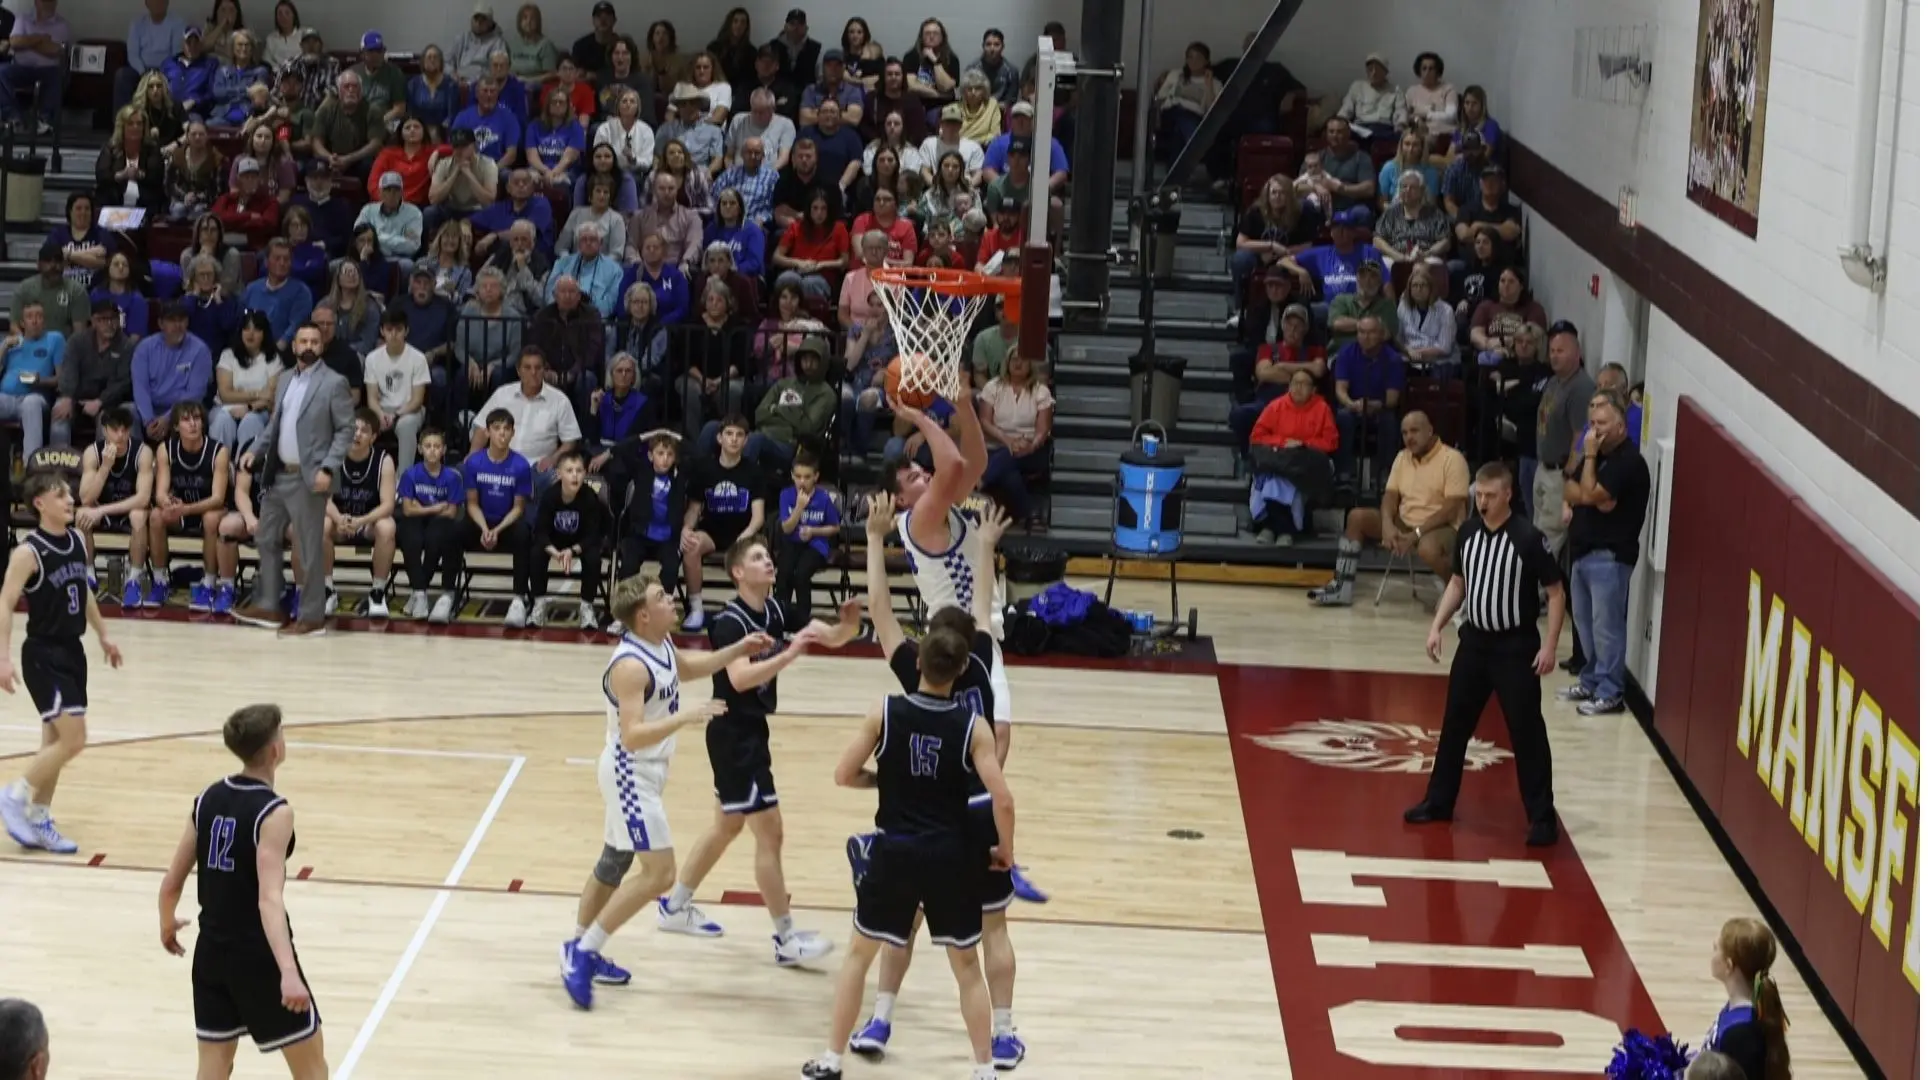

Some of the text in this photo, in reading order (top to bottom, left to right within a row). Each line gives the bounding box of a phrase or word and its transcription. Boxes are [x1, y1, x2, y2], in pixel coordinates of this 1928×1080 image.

[36, 451, 80, 468] LIONS
[67, 583, 80, 615] 3
[909, 733, 942, 780] 15
[207, 814, 236, 872] 12
